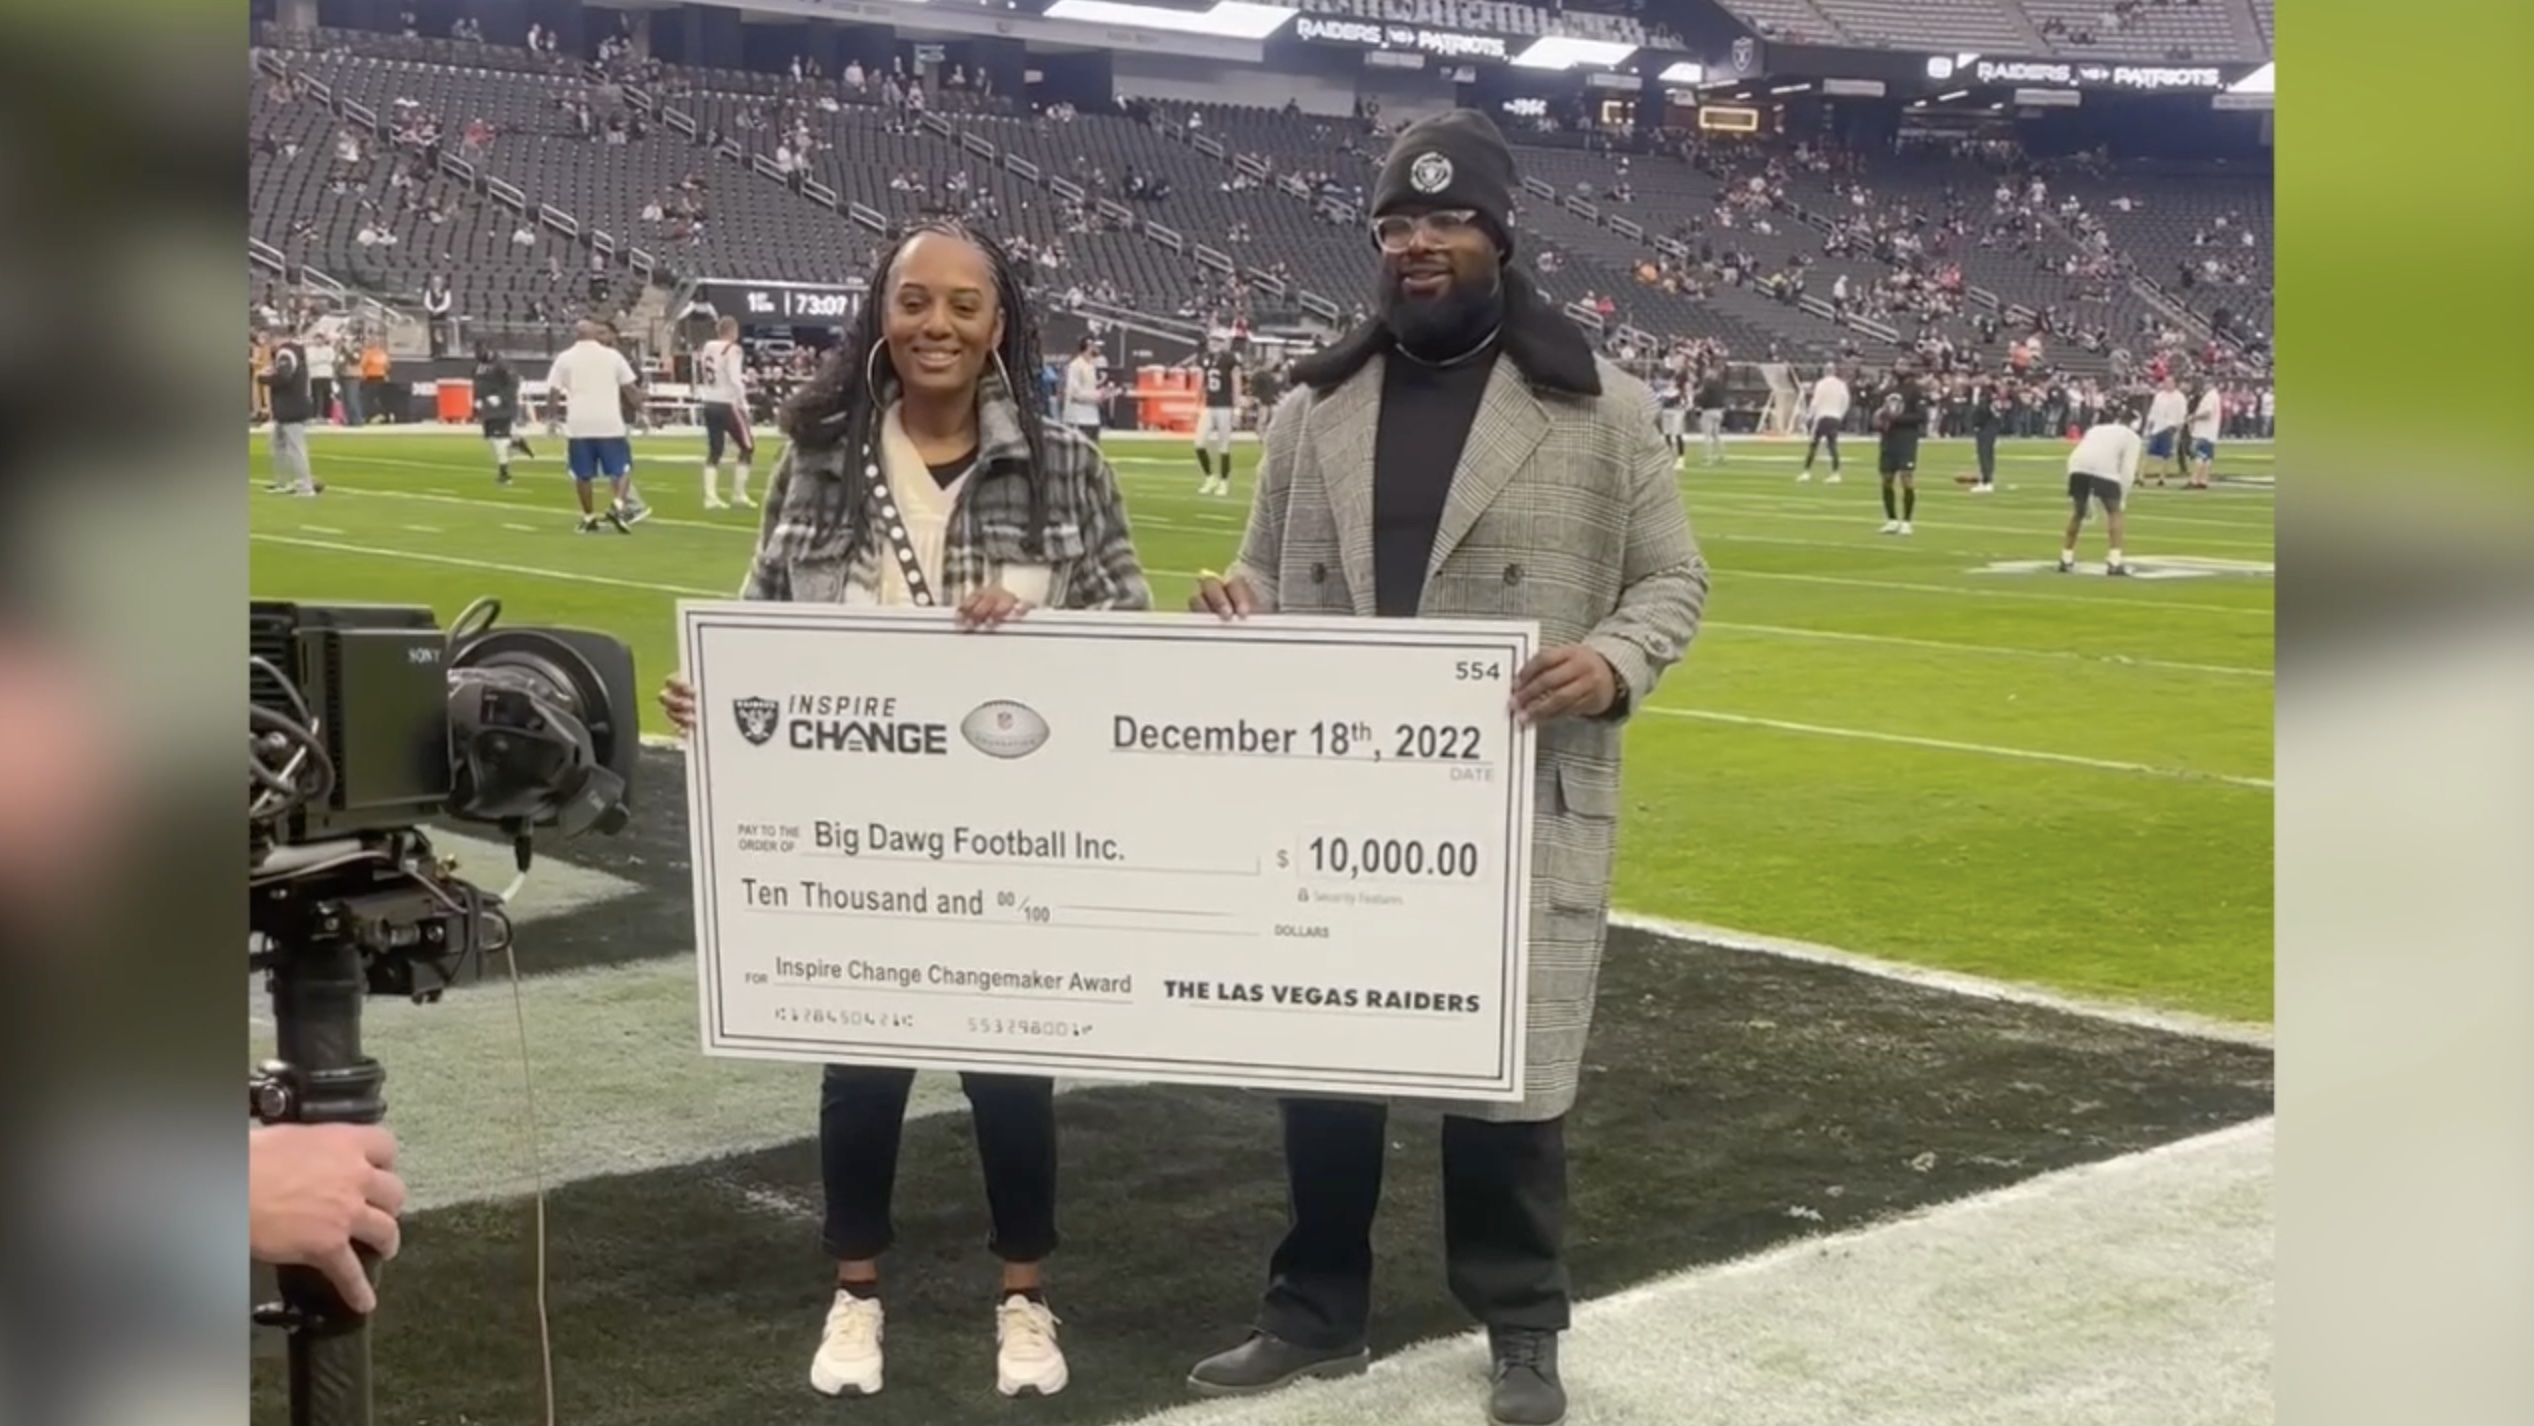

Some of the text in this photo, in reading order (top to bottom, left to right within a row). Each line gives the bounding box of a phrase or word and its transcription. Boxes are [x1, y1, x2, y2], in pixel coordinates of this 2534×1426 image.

[795, 294, 848, 316] 73:07
[408, 648, 441, 664] SONY
[1455, 661, 1501, 681] 554
[788, 694, 897, 717] INSPIRE
[789, 719, 948, 755] CHANGE
[1113, 715, 1482, 763] December 18th, 2022
[1450, 767, 1494, 783] DATE
[738, 824, 800, 838] PAY TO THE
[815, 821, 1126, 861] Big Dawg Football Inc.
[738, 838, 794, 852] ORDER OF
[1276, 837, 1478, 878] $ 10,000.00
[741, 878, 788, 907] Ten
[801, 881, 928, 915] Thousand
[937, 890, 984, 915] and
[1274, 924, 1330, 938] DOLLARS
[744, 957, 1133, 994] FOR Inspire Change Changemaker Award
[1164, 980, 1481, 1013] THE LAS VEGAS RAIDERS
